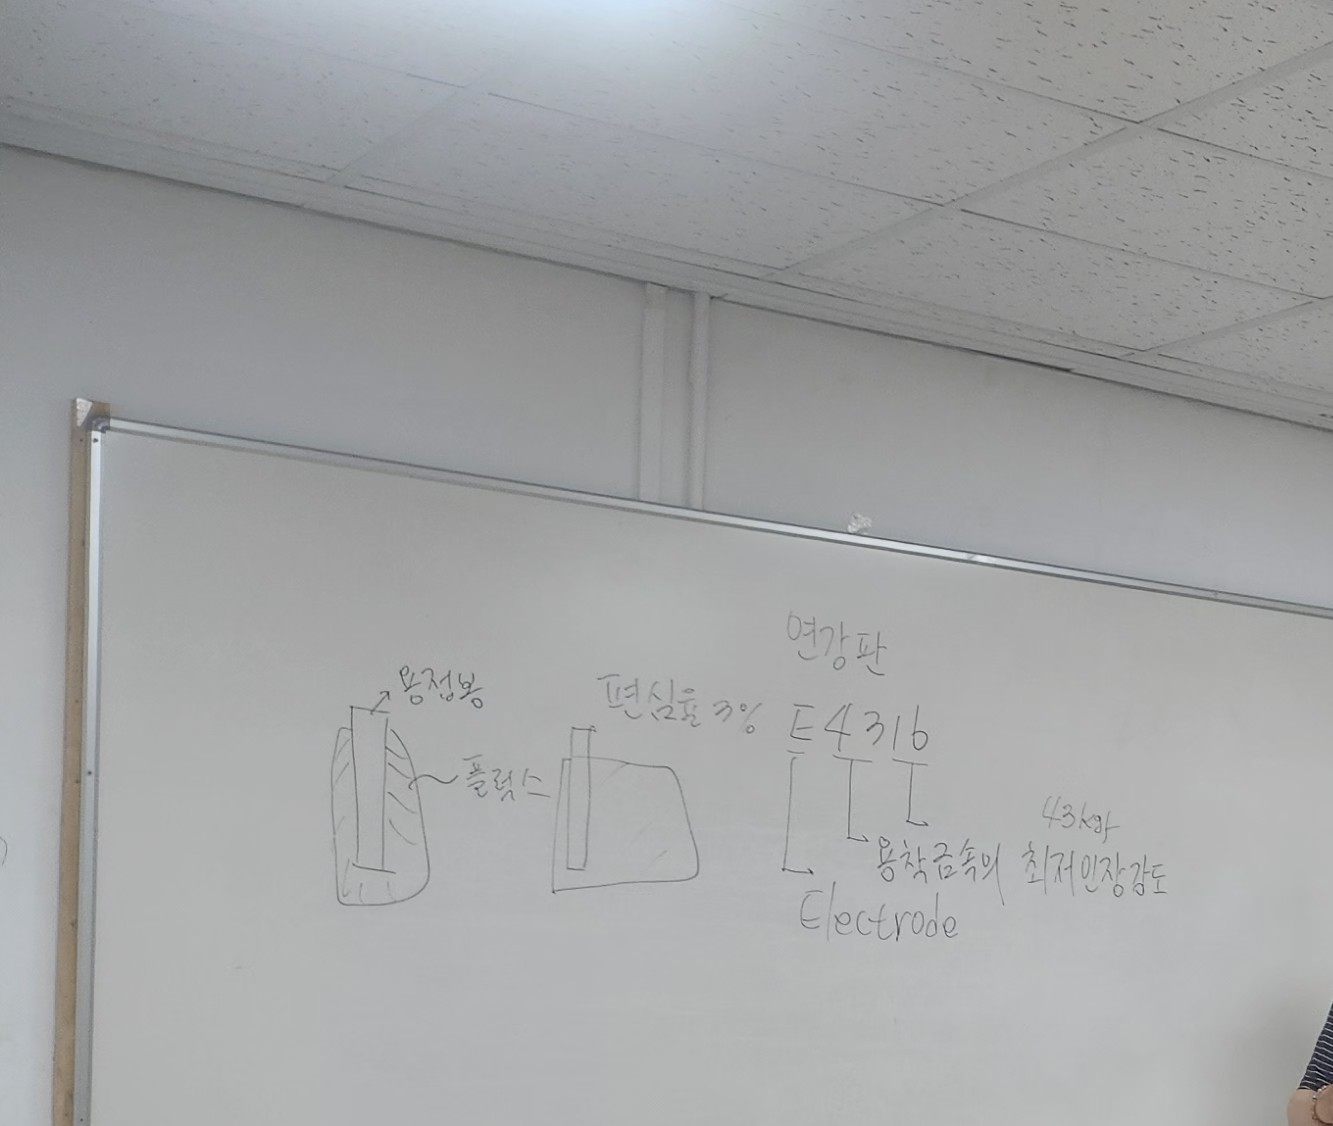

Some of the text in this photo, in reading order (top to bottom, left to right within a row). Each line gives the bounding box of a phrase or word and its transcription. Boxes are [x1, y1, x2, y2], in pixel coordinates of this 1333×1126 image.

[786, 610, 888, 676] 연강판
[789, 702, 929, 752] E4316
[800, 880, 959, 942] Electrode
